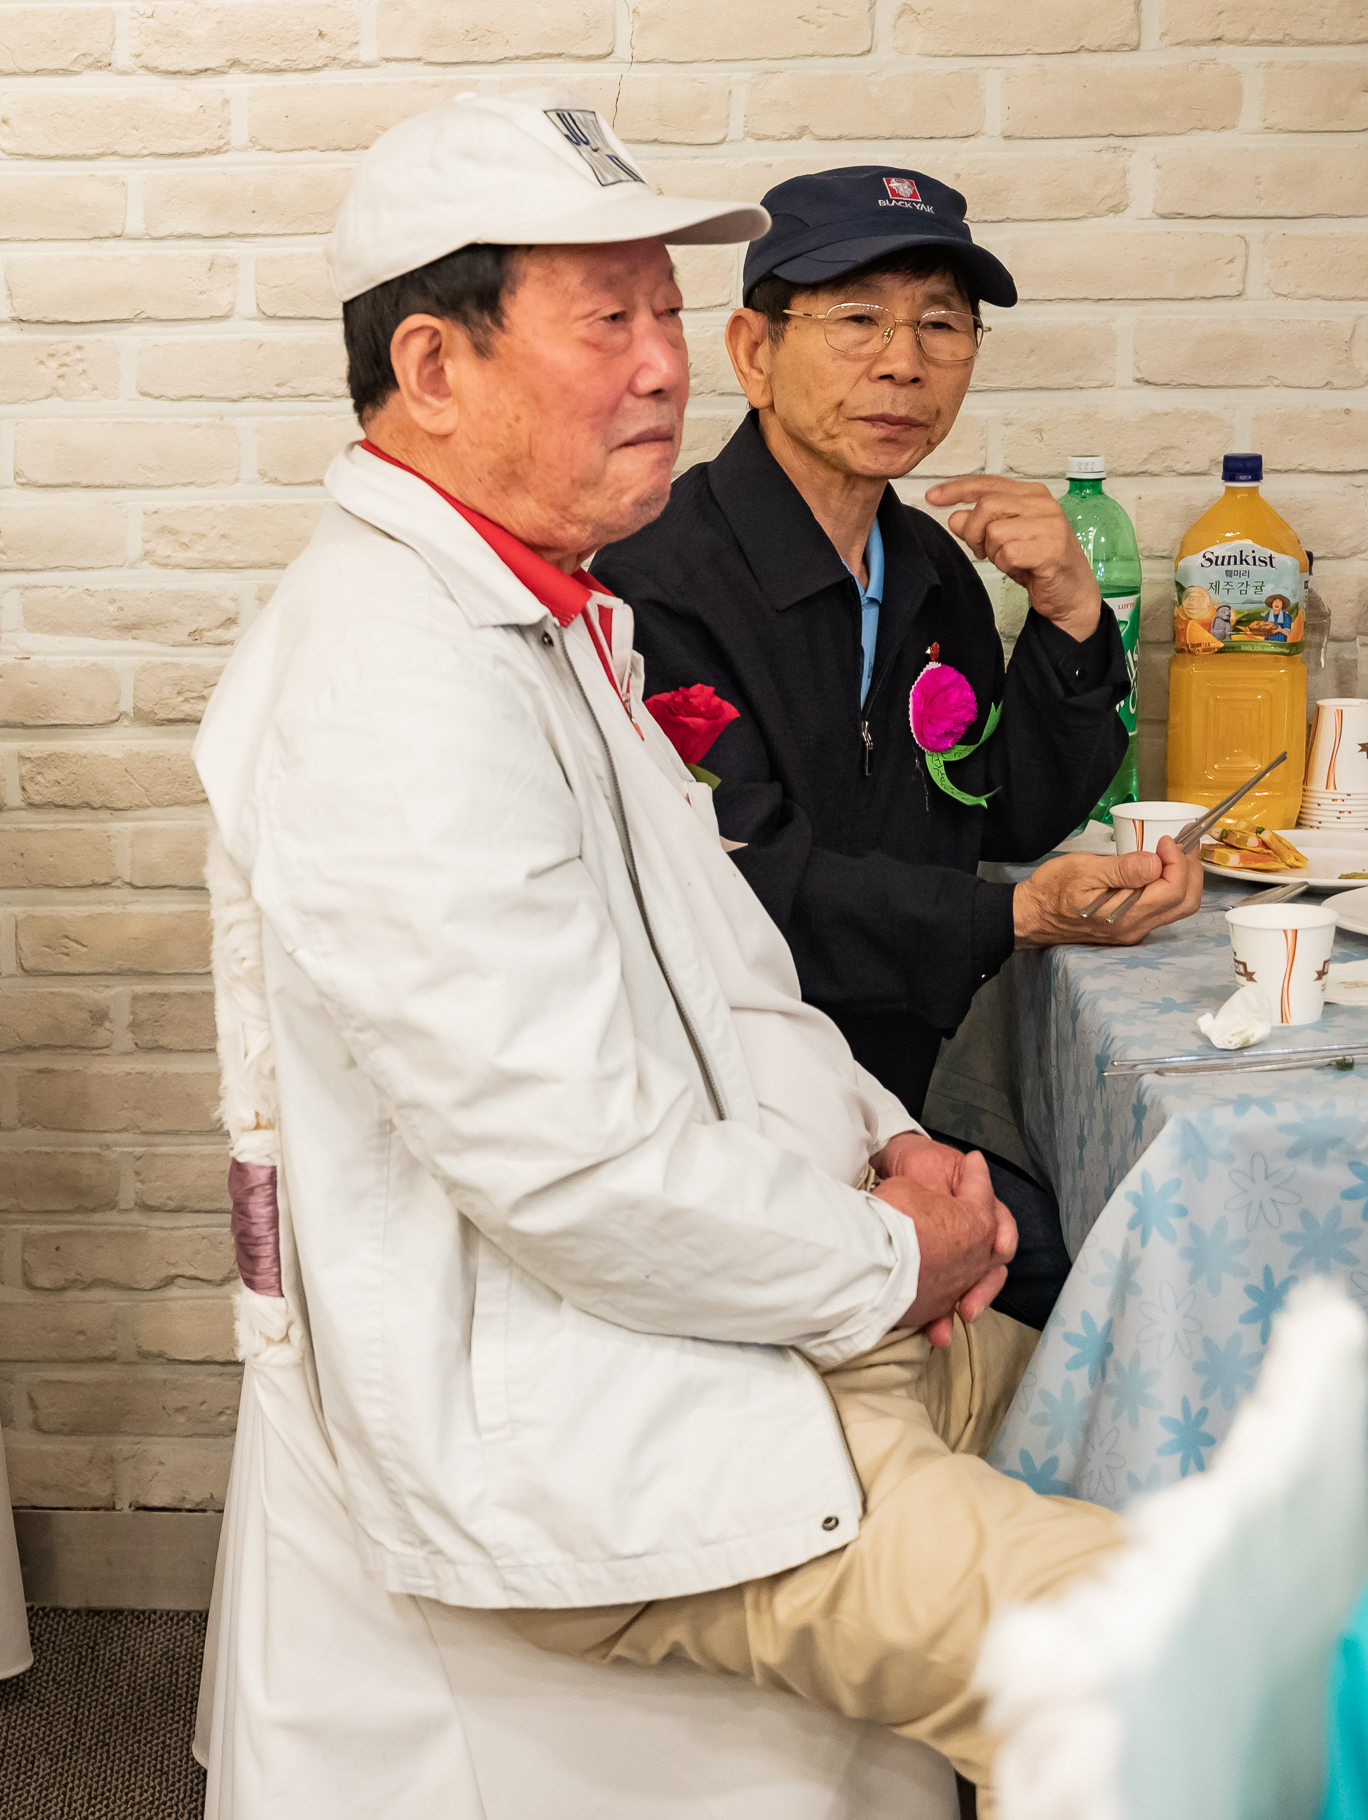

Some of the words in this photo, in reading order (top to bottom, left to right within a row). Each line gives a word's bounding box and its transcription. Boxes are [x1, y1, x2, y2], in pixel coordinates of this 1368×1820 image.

[1200, 549, 1277, 569] Sunkist
[1225, 569, 1250, 579] 훼미리
[1207, 579, 1265, 596] 제주감귤
